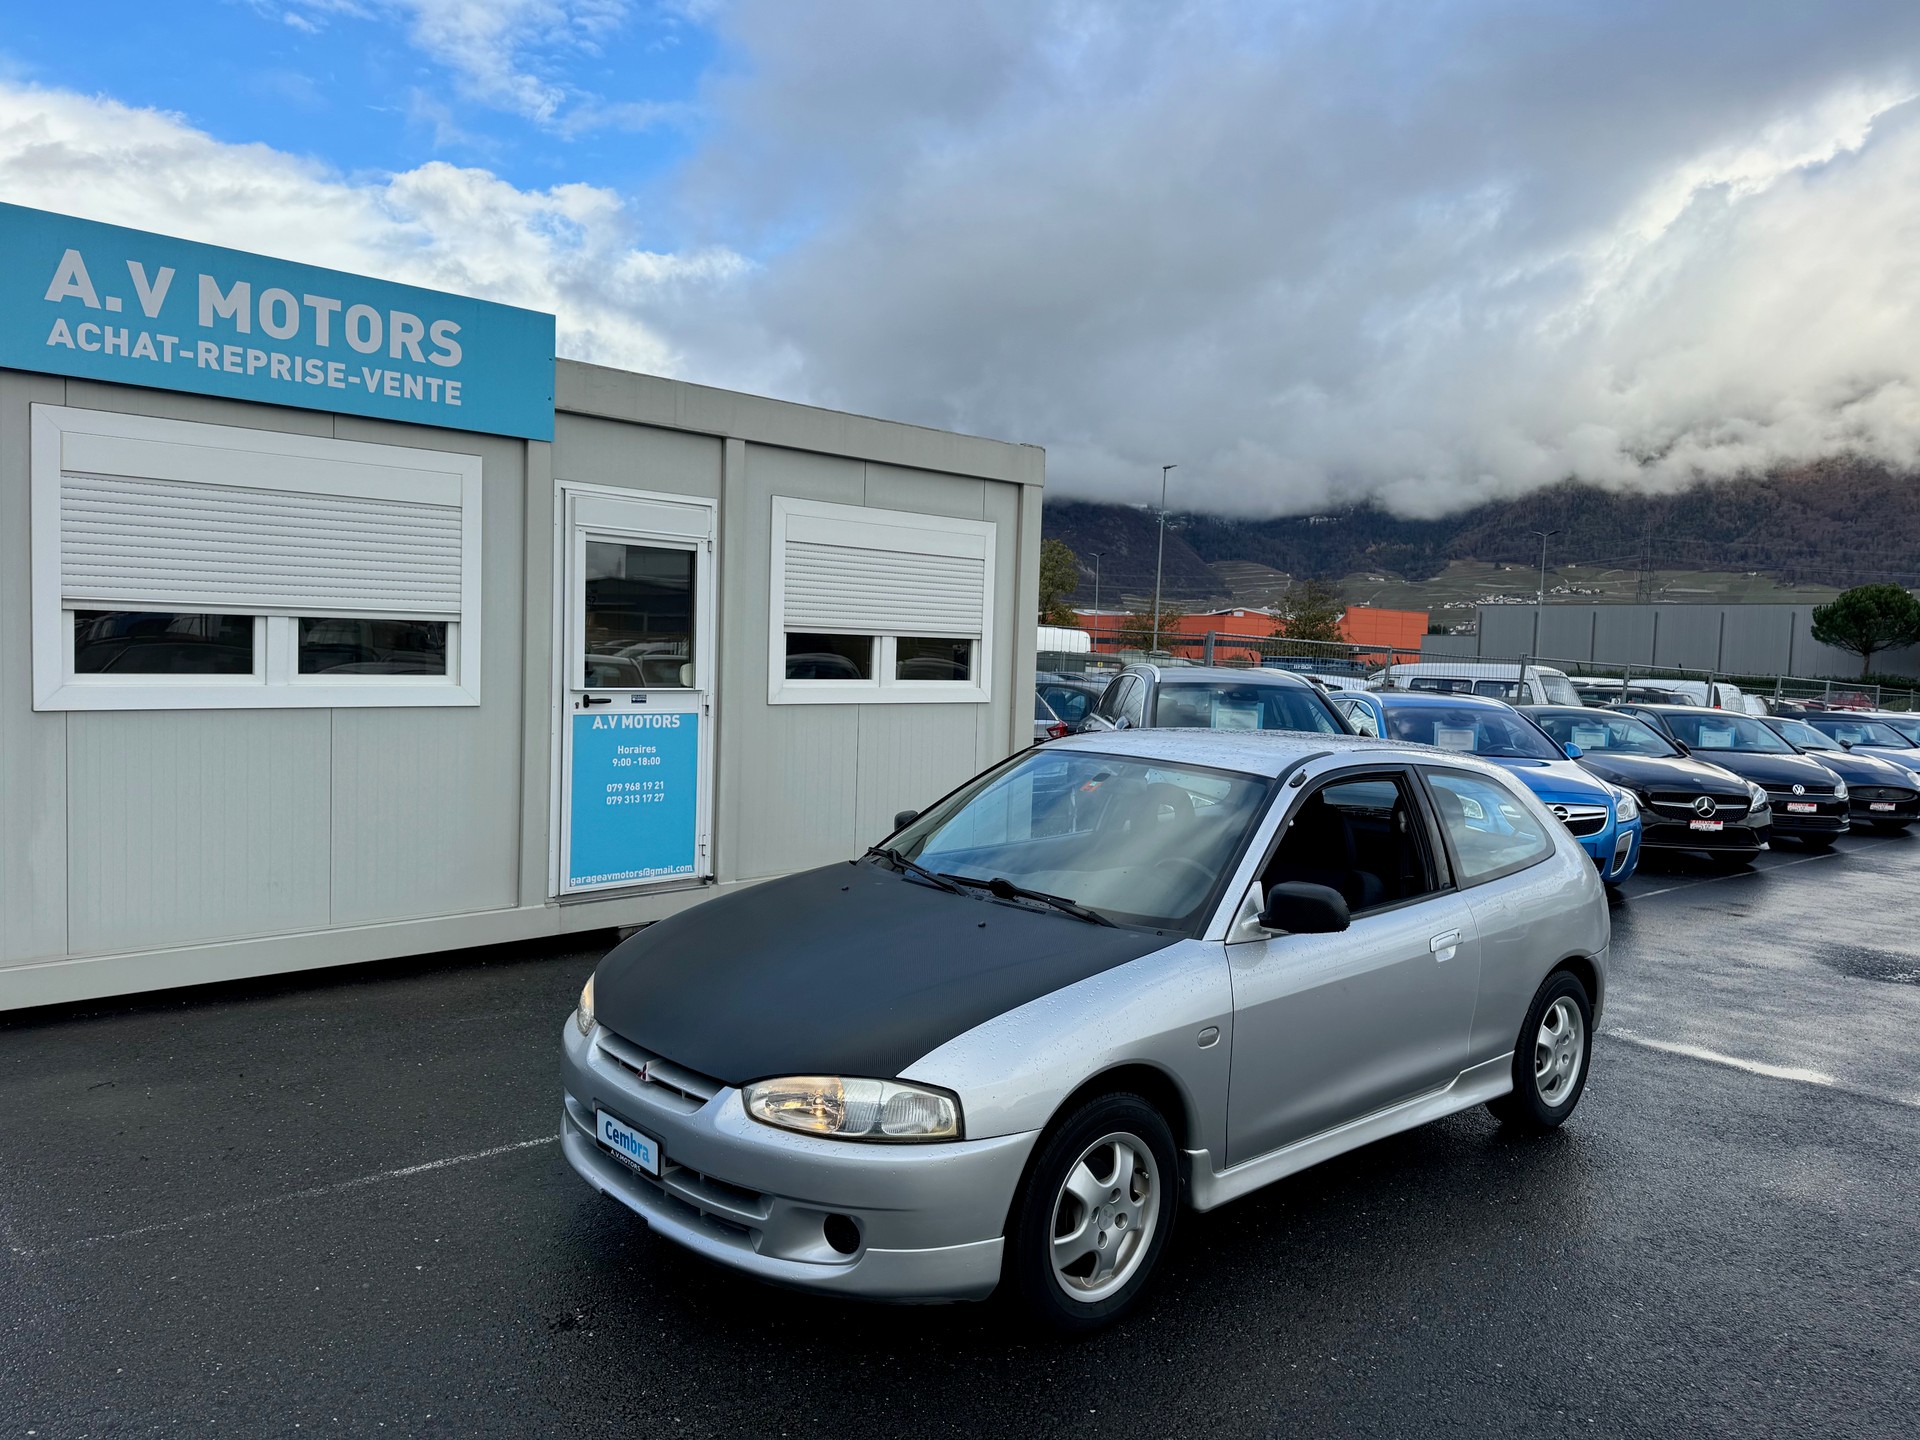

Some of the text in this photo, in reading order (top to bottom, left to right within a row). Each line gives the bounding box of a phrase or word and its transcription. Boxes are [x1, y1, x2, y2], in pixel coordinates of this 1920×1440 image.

[44, 248, 463, 367] A.V MOTORS
[46, 318, 462, 406] ACHAT-REPRISE-VENTE
[592, 714, 680, 729] A.V MOTORS
[617, 745, 657, 754] Horaires
[612, 758, 631, 767] 9:00
[606, 780, 664, 792] 079 968 19 21
[606, 793, 665, 805] 079 313 17 27
[570, 864, 693, 886] garageavmotors@gmail.com
[605, 1120, 650, 1163] Cembra
